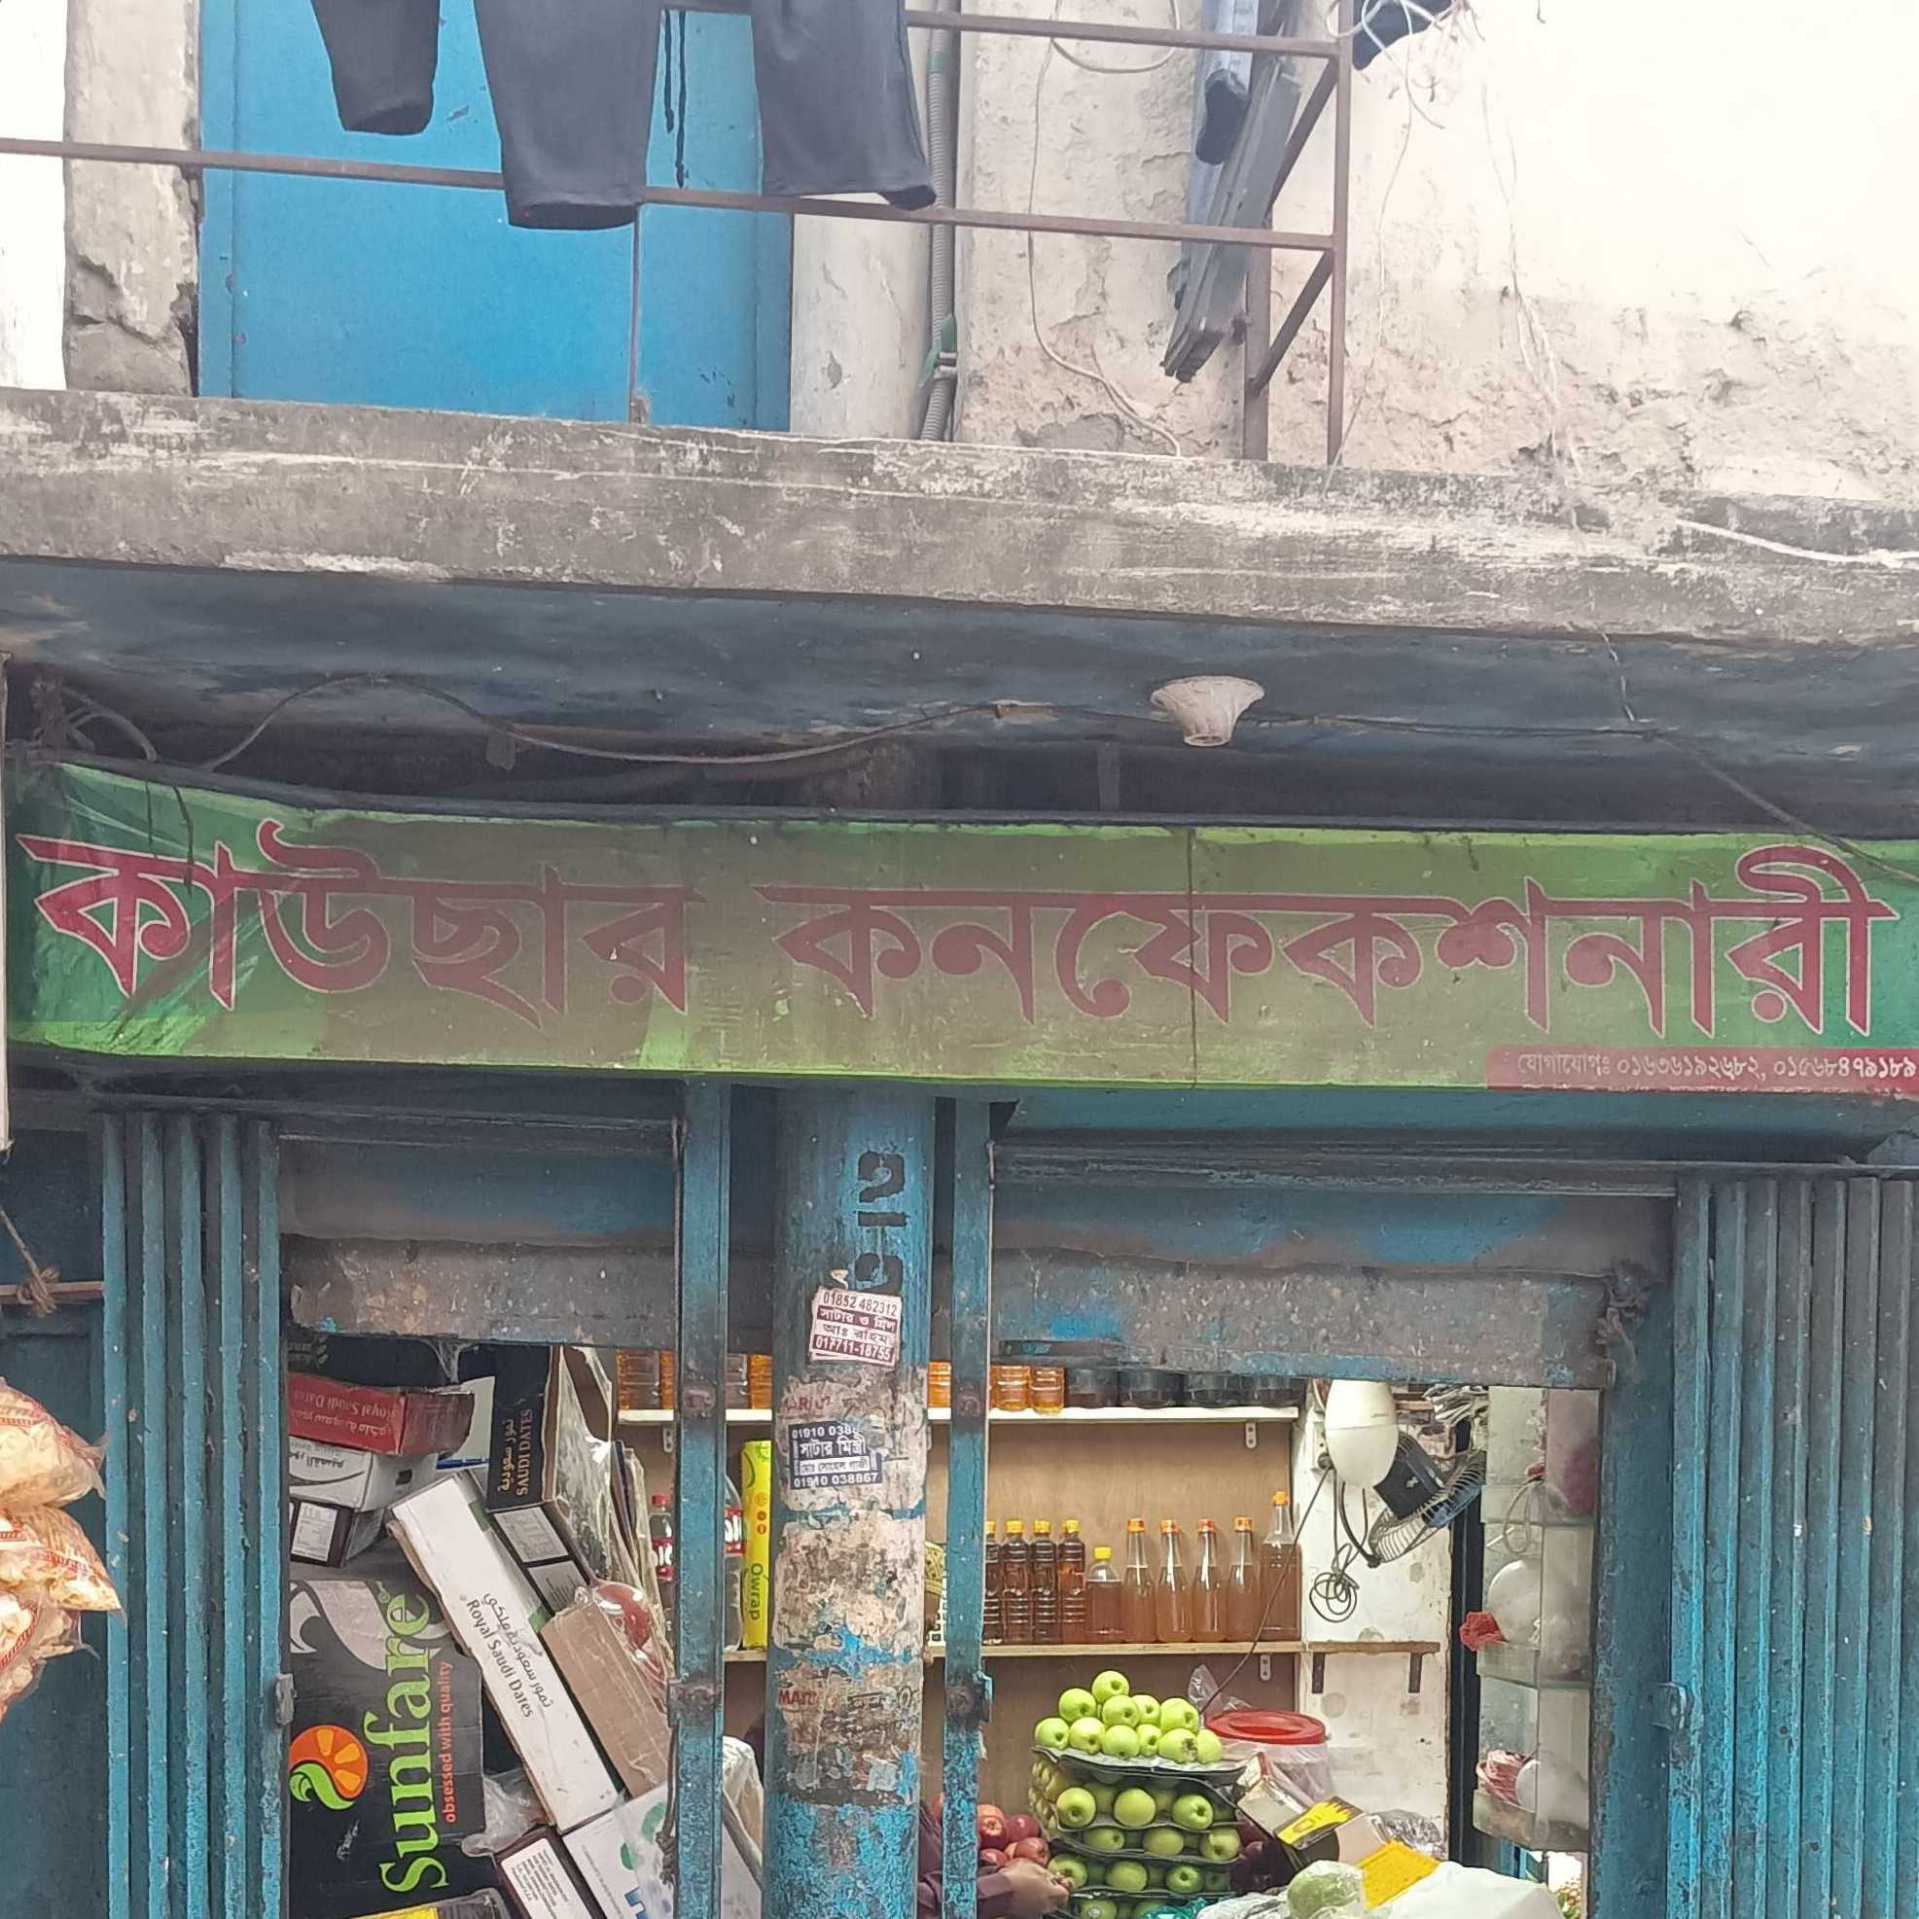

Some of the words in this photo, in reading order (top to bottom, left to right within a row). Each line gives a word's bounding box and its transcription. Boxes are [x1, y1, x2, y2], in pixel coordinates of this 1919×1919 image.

[15, 818, 705, 1029] কাউছার
[750, 844, 1902, 1039] কনফেকশনারী
[515, 1453, 531, 1497] SAUDI
[438, 1661, 453, 1713] quality
[462, 1598, 497, 1643] Royal
[485, 1639, 517, 1680] Saudi
[506, 1678, 539, 1720] Dates
[363, 1593, 450, 1893] Sunfare
[437, 1717, 452, 1750] with
[438, 1753, 457, 1823] obsessed
